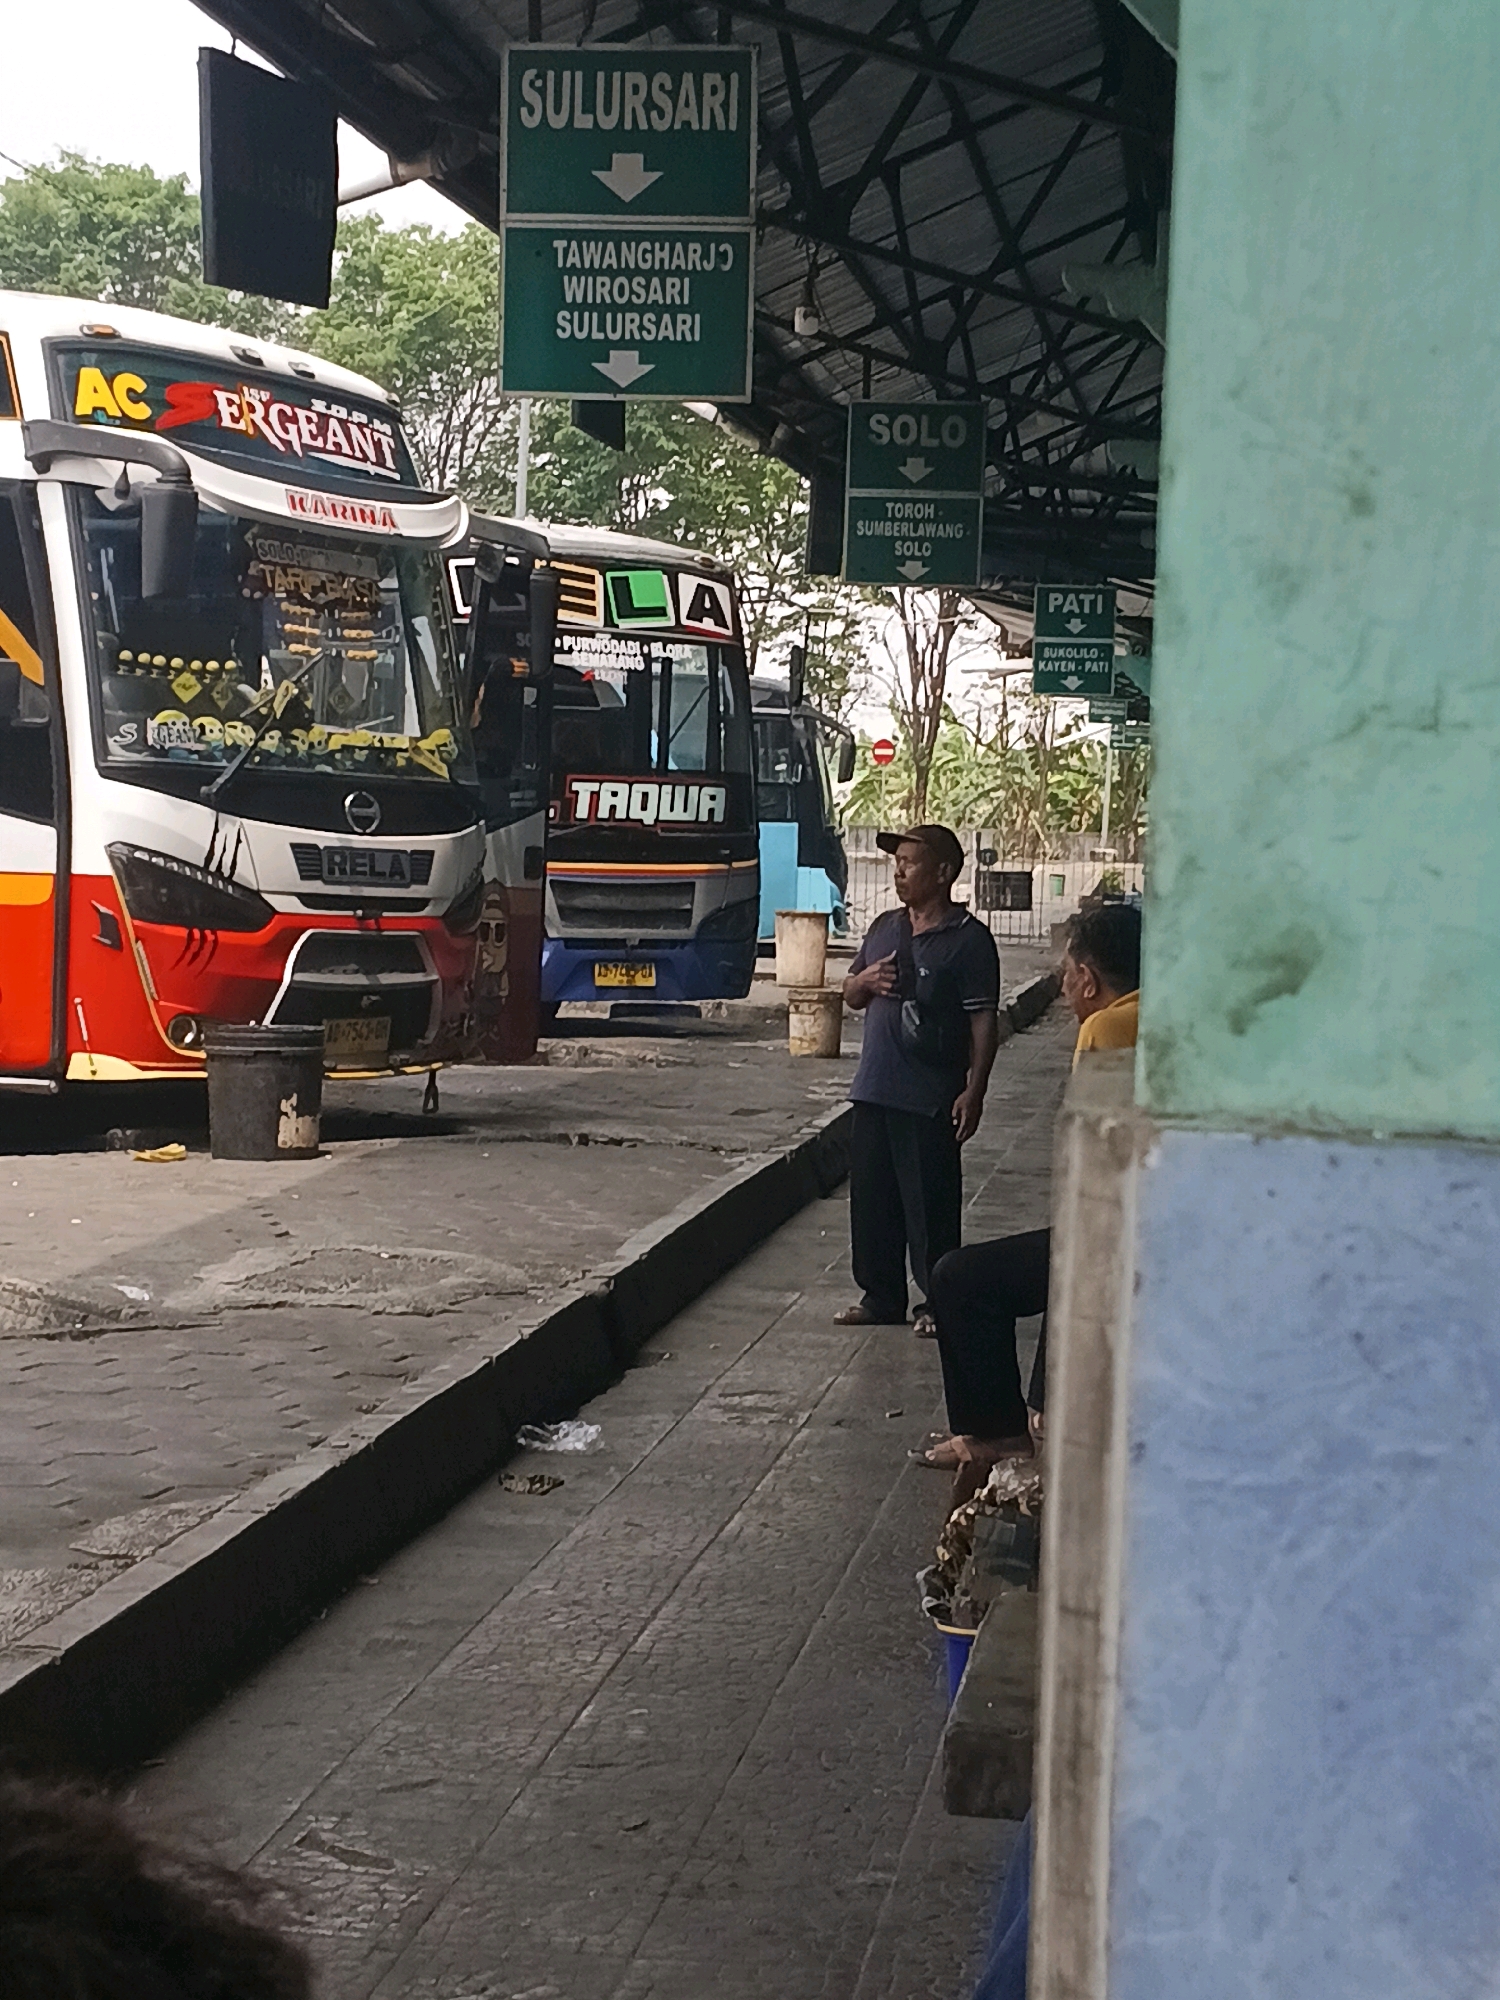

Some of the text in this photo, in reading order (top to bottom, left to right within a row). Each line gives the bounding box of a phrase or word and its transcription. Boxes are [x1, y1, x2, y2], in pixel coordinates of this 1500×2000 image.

[520, 68, 740, 132] SULURSARI
[563, 275, 690, 305] WIROSARI
[556, 310, 701, 343] SULURSARI
[74, 367, 152, 420] AC
[868, 413, 968, 449] SOLO
[286, 490, 400, 531] KARINA
[885, 502, 935, 519] TOROH
[856, 521, 964, 540] SUMBERLAWANG
[894, 540, 932, 557] SOLO
[1048, 592, 1104, 615] PATI
[1084, 661, 1109, 673] PATI
[571, 782, 726, 825] TAQWA
[327, 849, 406, 880] RELA
